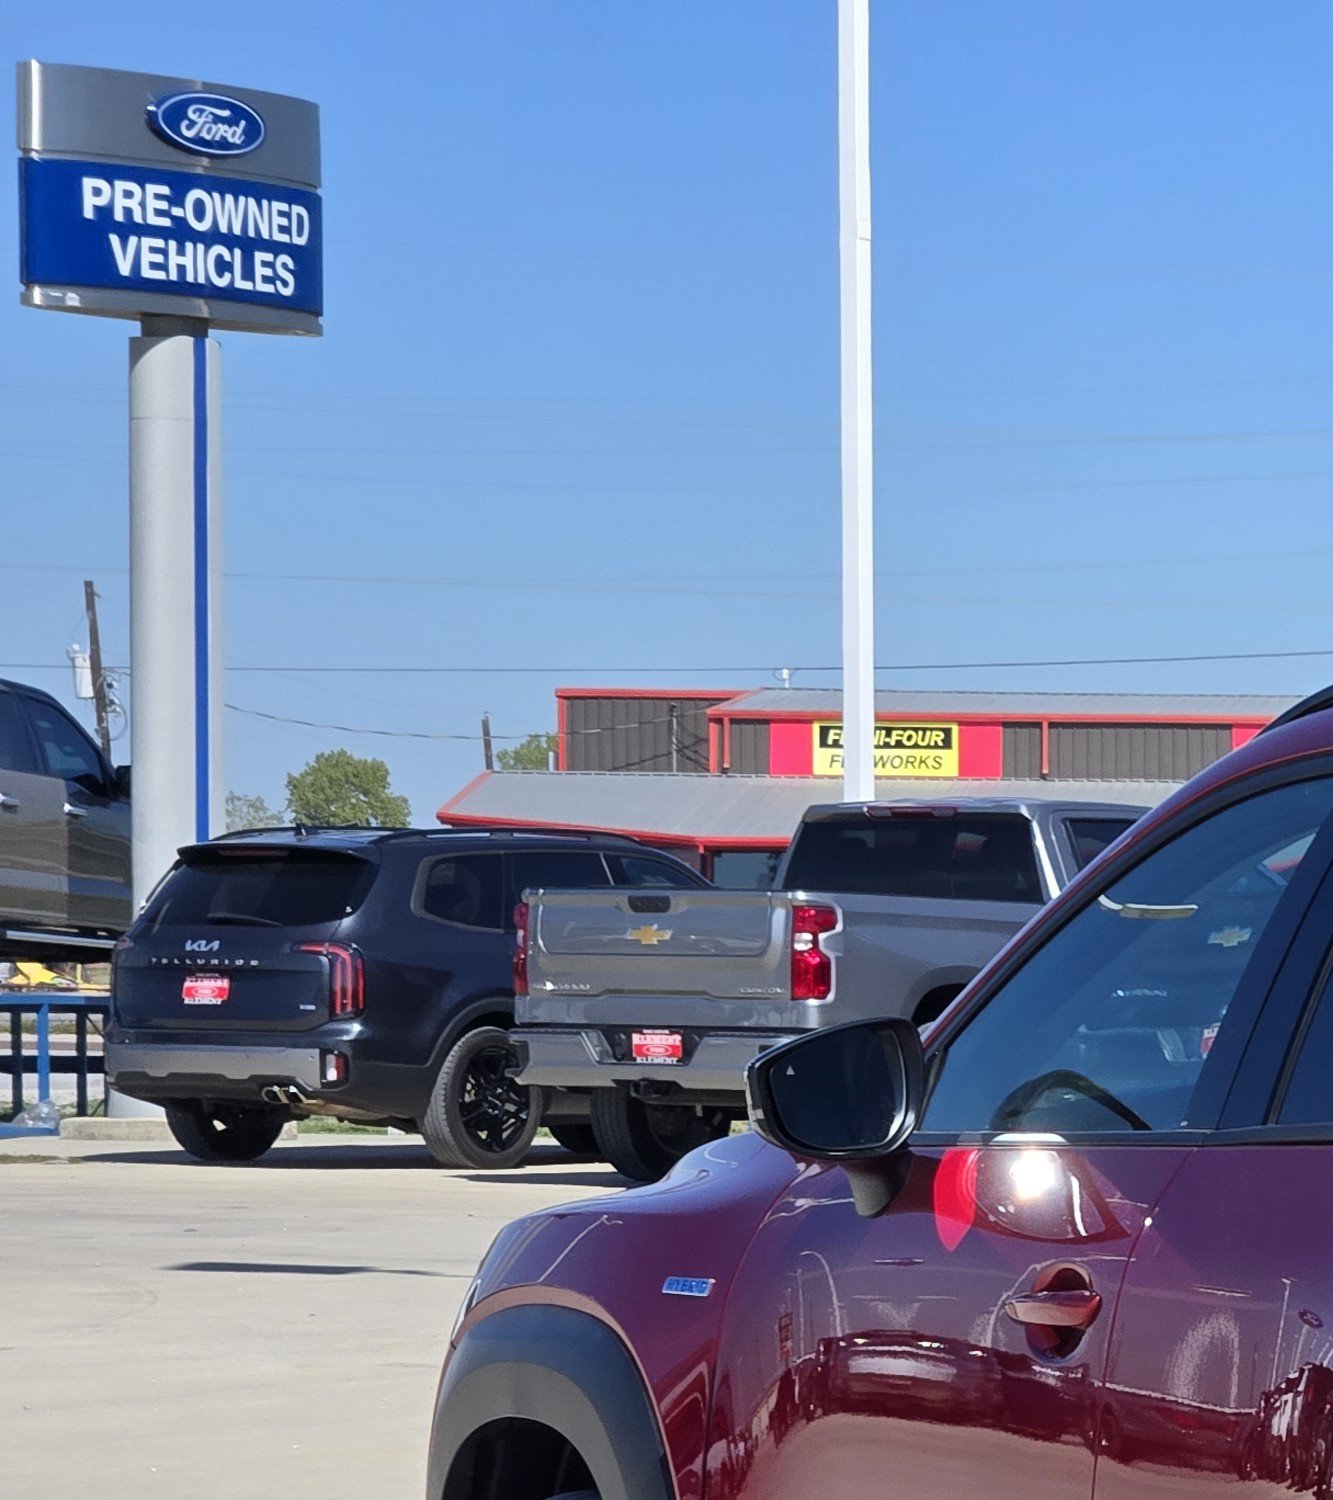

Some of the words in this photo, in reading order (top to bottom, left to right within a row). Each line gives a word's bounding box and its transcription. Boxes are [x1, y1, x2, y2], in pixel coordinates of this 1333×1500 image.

[180, 103, 246, 145] Ford
[82, 177, 310, 246] PRE-OWNED
[109, 233, 295, 297] VEHICLES
[829, 754, 943, 770] FIWORKS
